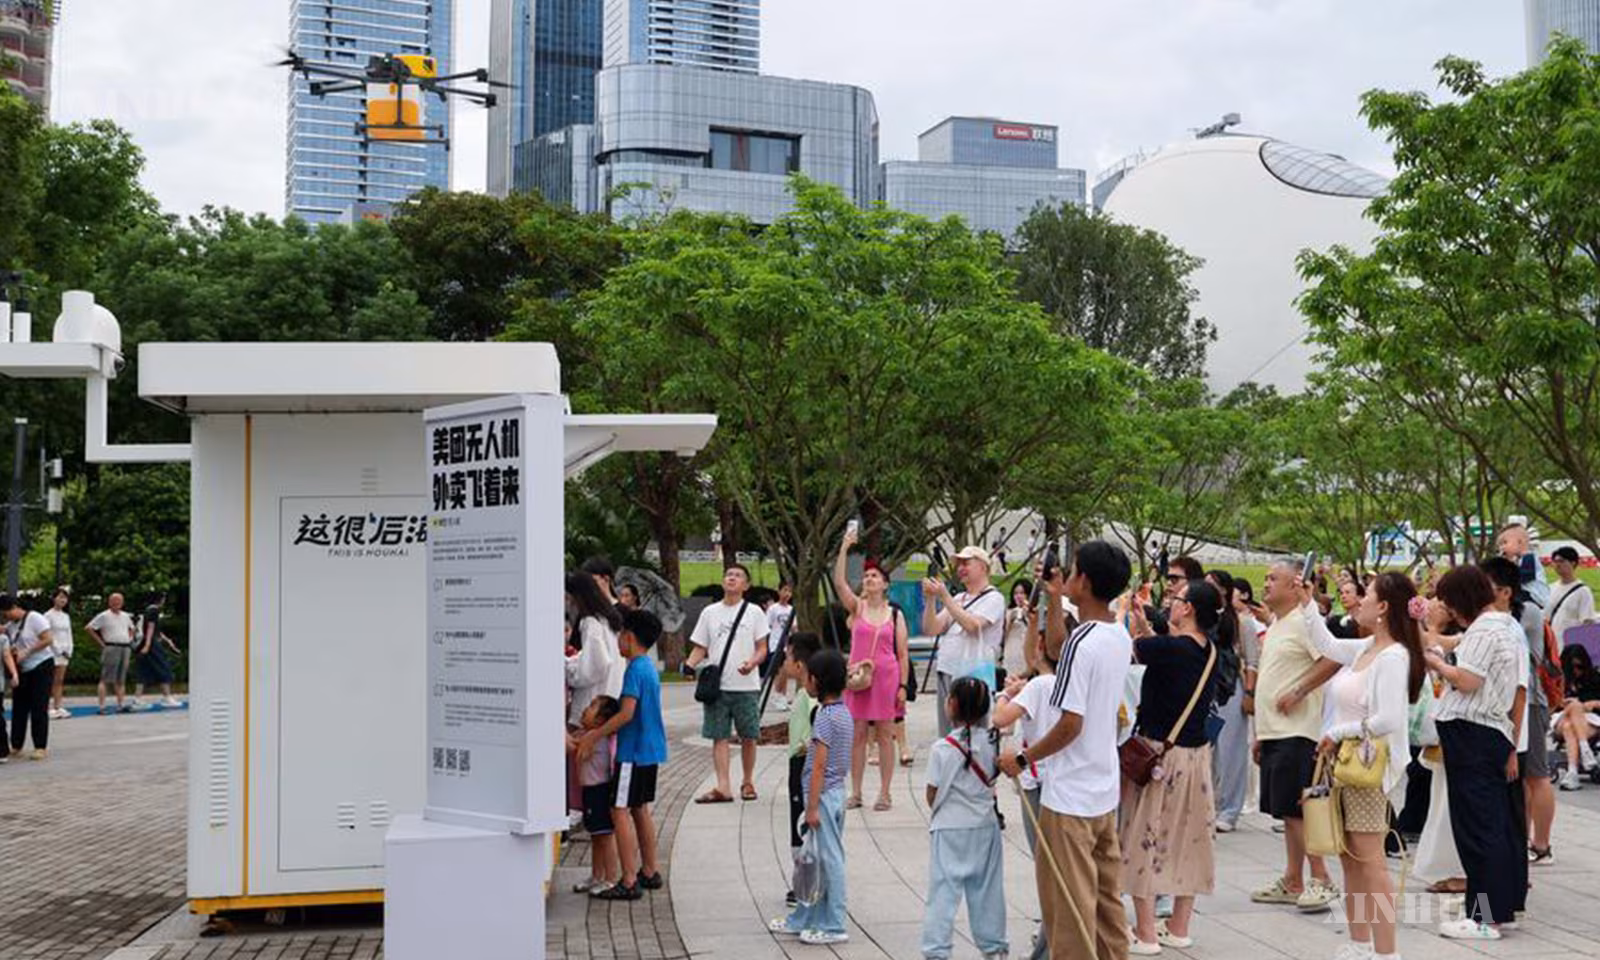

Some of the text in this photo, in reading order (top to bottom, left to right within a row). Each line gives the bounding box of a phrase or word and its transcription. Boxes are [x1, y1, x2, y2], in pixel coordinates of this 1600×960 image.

[433, 418, 519, 466] 美团无人机
[433, 465, 519, 511] 外卖飞着来
[353, 549, 364, 557] IS
